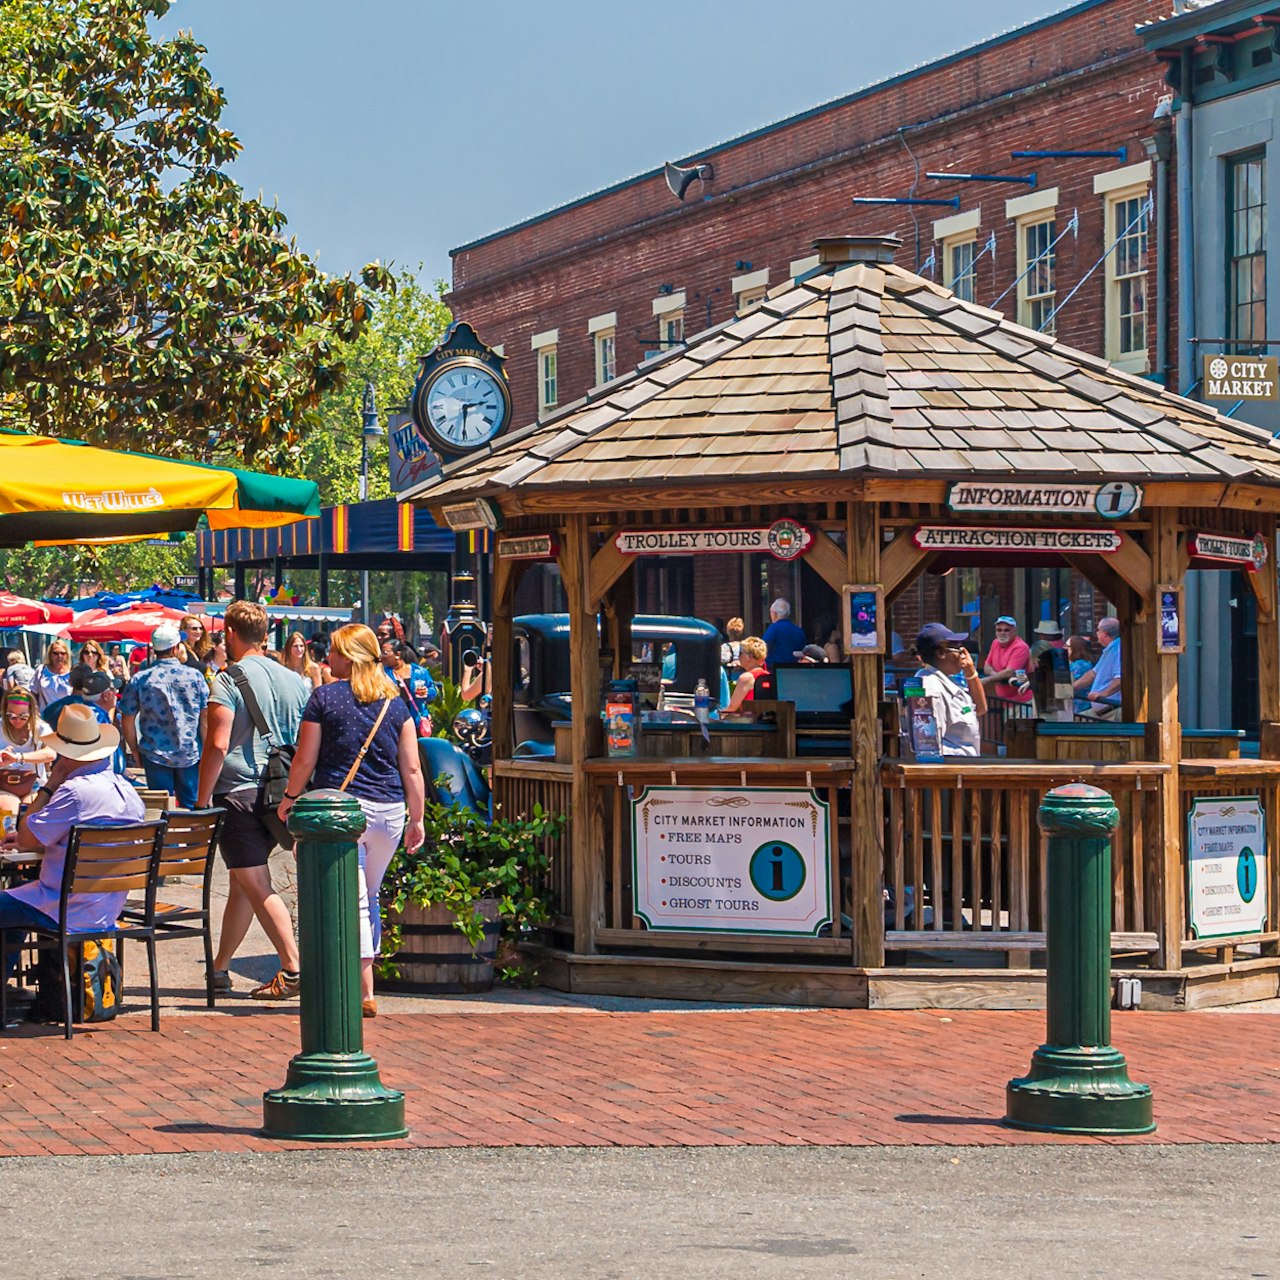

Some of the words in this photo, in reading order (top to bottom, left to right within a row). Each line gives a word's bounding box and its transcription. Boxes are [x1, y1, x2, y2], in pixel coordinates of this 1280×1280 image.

[435, 349, 455, 361] CITY
[456, 348, 492, 361] MARKET
[1231, 362, 1268, 378] CITY
[1208, 380, 1274, 396] MARKET
[63, 492, 102, 511] WET
[957, 488, 1091, 507] INFORMATION
[625, 533, 700, 549] TROLLEY
[703, 531, 761, 547] TOURS
[924, 529, 1037, 546] ATTRACTION
[1041, 532, 1114, 548] TICKETS
[1199, 537, 1229, 555] TROLLEY
[1229, 541, 1250, 557] TOURS
[654, 815, 677, 826] CITY
[682, 816, 726, 827] MARKET
[729, 817, 805, 828] INFORMATION
[1198, 826, 1209, 837] CITY
[1209, 825, 1227, 836] MARKET
[1228, 824, 1257, 835] INFORMATION
[668, 832, 702, 843] FREE
[705, 833, 742, 844] MAPS
[668, 854, 711, 865] TOURS
[669, 876, 742, 888] DISCOUNTS
[670, 898, 711, 909] GHOST
[715, 899, 759, 911] TOURS
